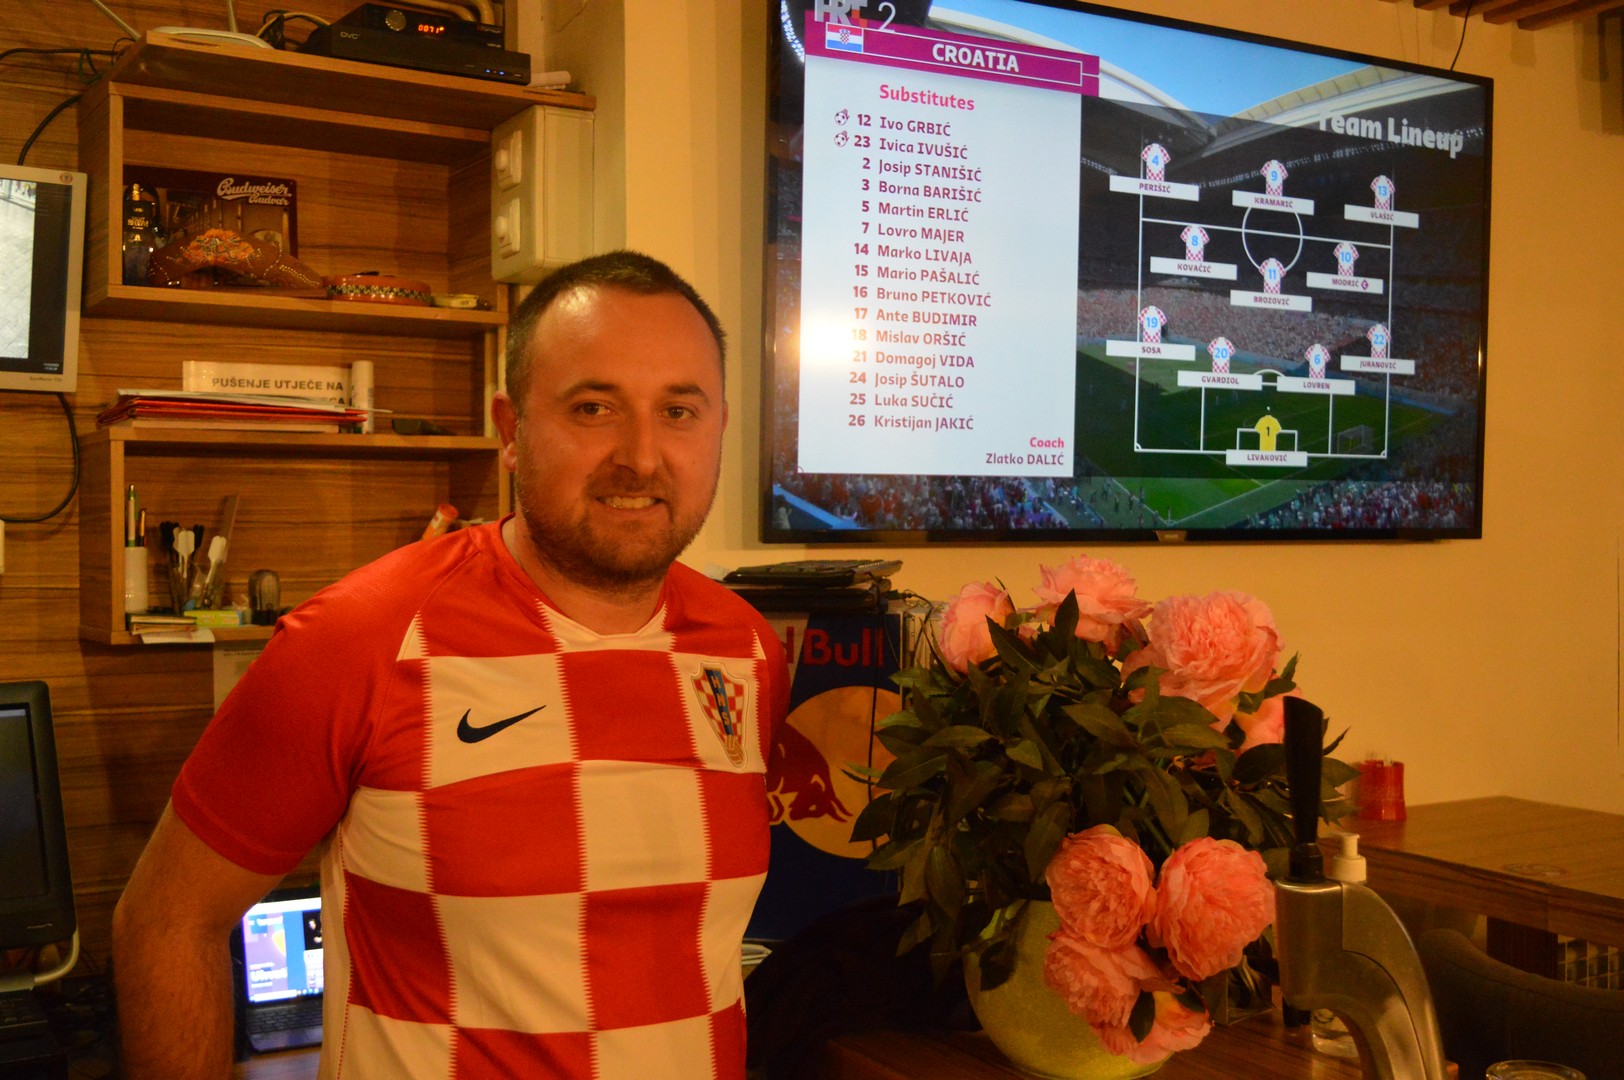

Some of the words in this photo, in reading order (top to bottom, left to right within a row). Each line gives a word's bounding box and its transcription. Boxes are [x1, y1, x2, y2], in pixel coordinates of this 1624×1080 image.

[878, 1, 896, 33] 2
[932, 44, 1019, 72] CROATIA
[879, 84, 975, 110] Substitutes
[857, 114, 872, 127] 12
[880, 117, 904, 131] Ivo
[907, 119, 951, 136] GRBIĆ
[1319, 113, 1382, 140] Team
[1388, 117, 1463, 159] Lineup
[854, 135, 871, 147] 23
[879, 138, 914, 154] Ivica
[917, 141, 968, 160] IVUŠIĆ
[1152, 155, 1160, 167] 4
[863, 158, 871, 169] 2
[879, 159, 911, 176] Josip
[915, 162, 982, 182] STANIŠIĆ
[1271, 171, 1278, 182] 9
[217, 177, 292, 201] Budweiser
[862, 179, 870, 191] 3
[879, 181, 920, 197] Borna
[923, 183, 982, 202] BARIŠIĆ
[1139, 182, 1171, 194] PERIŠIĆ
[1378, 186, 1389, 197] 13
[248, 194, 289, 206] Budvar
[861, 200, 870, 212] 5
[879, 203, 924, 218] Martin
[928, 205, 969, 222] ERLIĆ
[862, 222, 869, 234] 7
[878, 224, 918, 238] Lovro
[921, 227, 964, 244] MAJER
[1191, 235, 1200, 247] 8
[854, 243, 869, 255] 14
[878, 245, 922, 260] Marko
[925, 249, 972, 265] LIVAJA
[1341, 252, 1353, 263] 10
[855, 264, 869, 277] 15
[877, 267, 917, 281] Mario
[920, 267, 980, 286] PAŠALIĆ
[1268, 269, 1277, 280] 11
[1332, 278, 1359, 288] MODRIĆ
[853, 286, 868, 298] 16
[877, 288, 918, 302] Bruno
[921, 291, 991, 307] PETKOVIĆ
[854, 307, 868, 320] 17
[876, 309, 909, 323] Ante
[912, 311, 977, 326] BUDIMIR
[1146, 318, 1159, 329] 19
[876, 330, 920, 344] Mislav
[923, 331, 966, 347] ORŠIĆ
[1373, 335, 1385, 346] 22
[1141, 346, 1161, 355] SOSA
[1215, 348, 1229, 359] 20
[853, 351, 867, 363] 21
[875, 352, 936, 369] Domagoj
[940, 354, 975, 368] VIDA
[1314, 354, 1322, 365] 6
[1360, 361, 1397, 370] JURANOVIĆ
[212, 377, 270, 388] PUŠENJE
[274, 378, 322, 390] UTJEČE
[326, 381, 343, 390] NA
[849, 372, 867, 384] 24
[875, 373, 907, 388] Josip
[911, 372, 964, 388] ŠUTALO
[1202, 376, 1239, 385] GVARDIOL
[1303, 382, 1330, 390] LOVREN
[850, 393, 866, 405] 25
[875, 394, 908, 408] Luka
[911, 392, 953, 408] SUČIĆ
[848, 414, 865, 427] 26
[874, 415, 932, 431] Kristijan
[935, 416, 974, 432] JAKIĆ
[1266, 427, 1271, 438] 1
[1029, 436, 1064, 448] Coach
[986, 453, 1024, 464] Zlatko
[1027, 452, 1064, 465] DALIĆ
[804, 627, 883, 667] Bull
[711, 675, 730, 725] HNS
